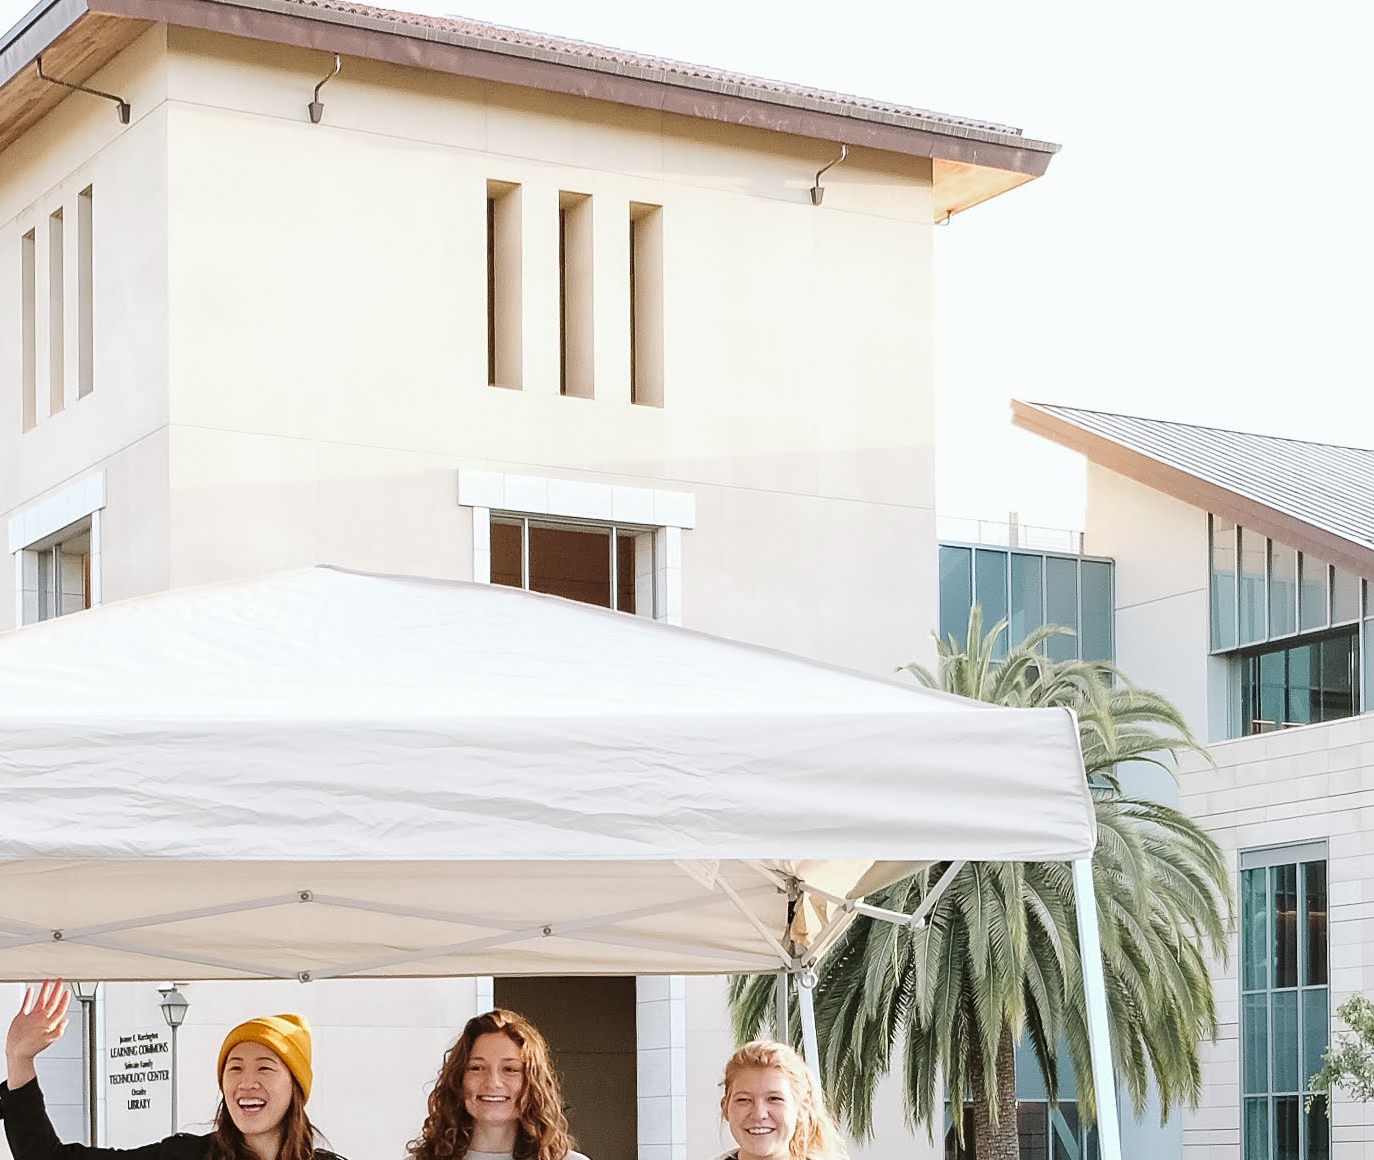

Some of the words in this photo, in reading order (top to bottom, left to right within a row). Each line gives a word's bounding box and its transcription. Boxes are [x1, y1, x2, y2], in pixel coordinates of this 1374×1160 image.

[110, 1046, 138, 1058] LEARNING
[138, 1042, 169, 1055] COMMONS
[109, 1072, 146, 1085] TECHNOLOGY
[147, 1070, 170, 1082] CENTER
[127, 1098, 151, 1110] LIBRARY
